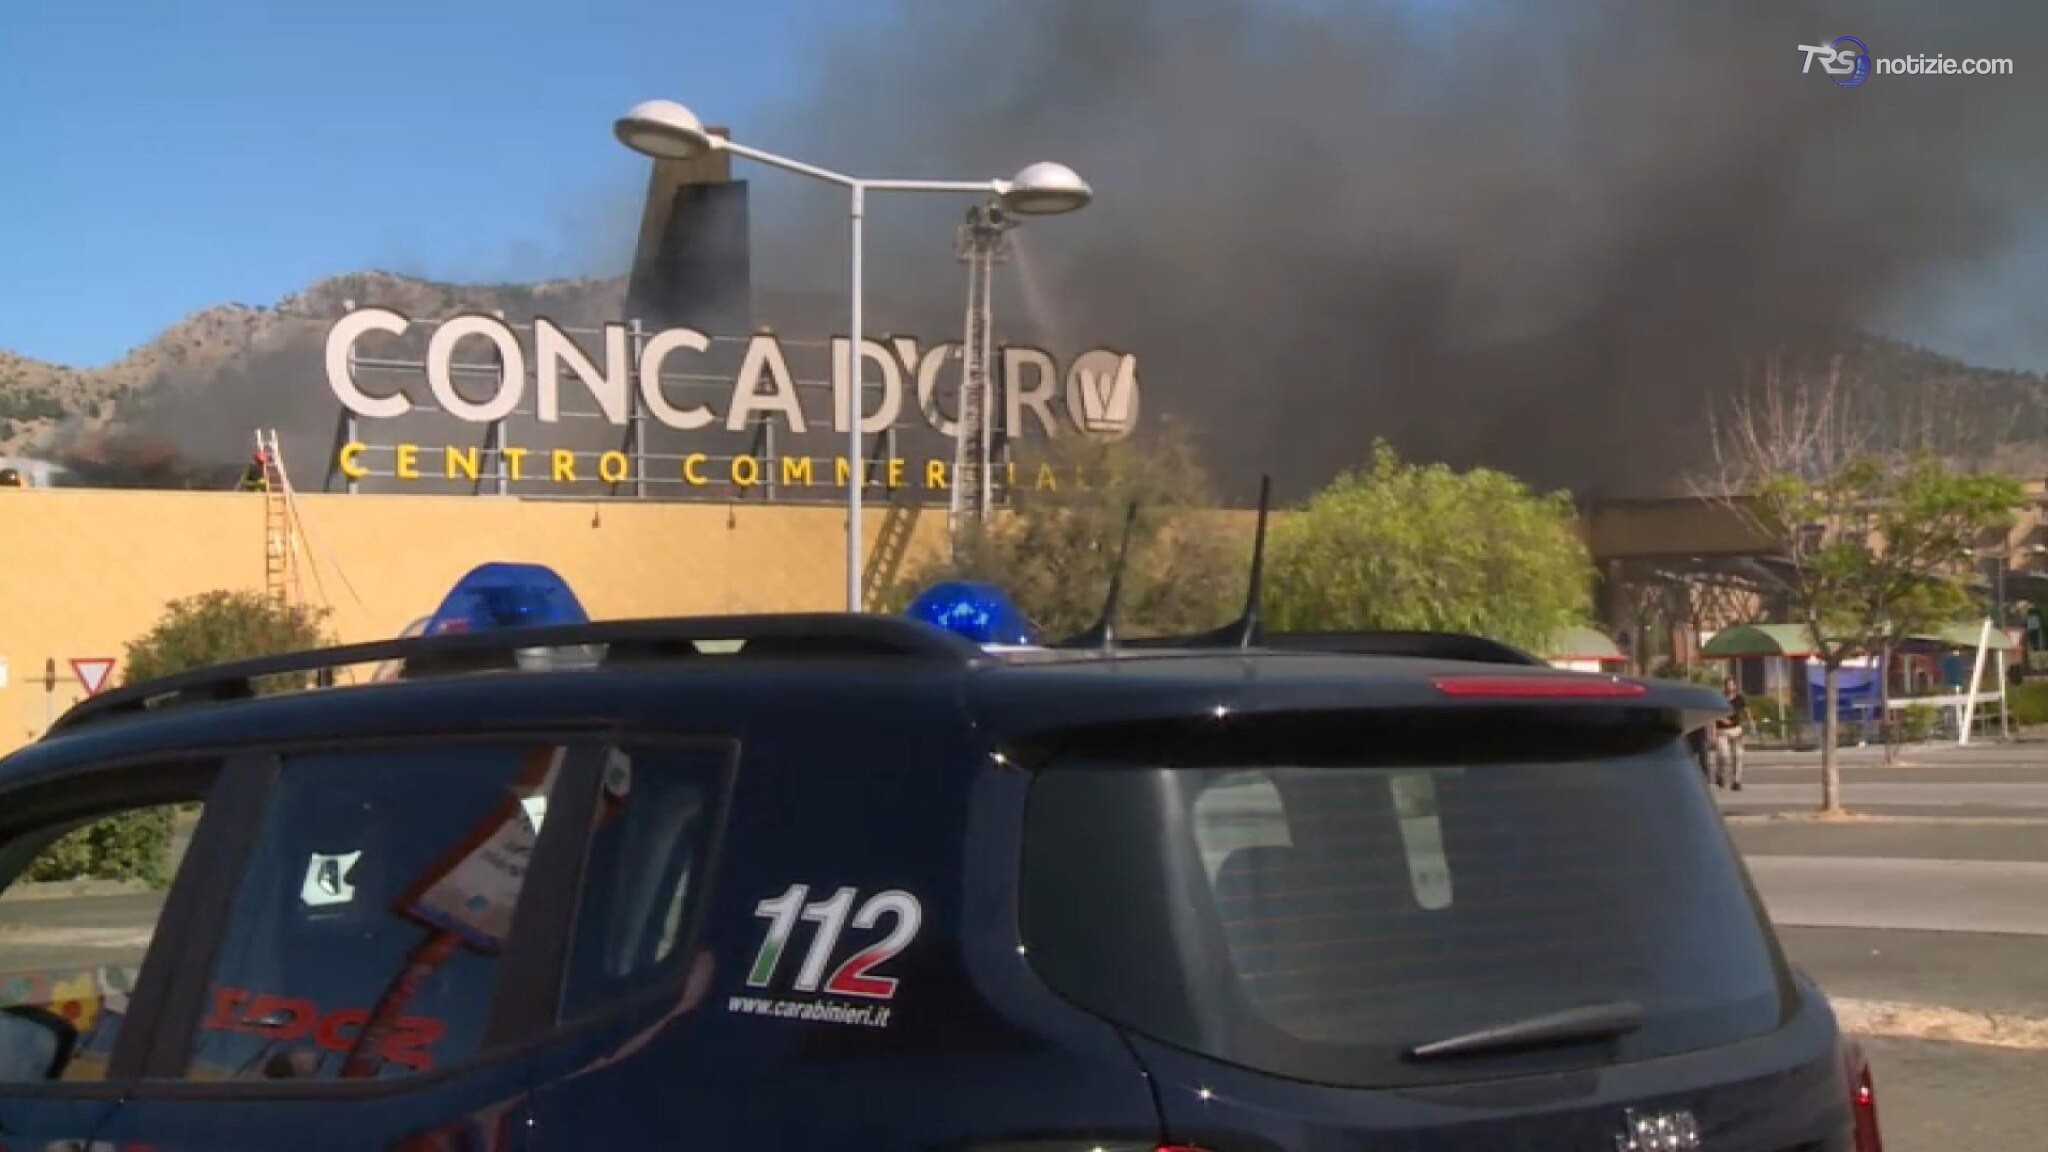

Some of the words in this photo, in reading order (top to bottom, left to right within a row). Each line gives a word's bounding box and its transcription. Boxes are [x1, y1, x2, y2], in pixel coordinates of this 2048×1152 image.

[325, 308, 808, 432] CONCA
[339, 441, 630, 482] CENTRO
[746, 883, 922, 999] 112
[728, 996, 891, 1027] www.carabinieri.it
